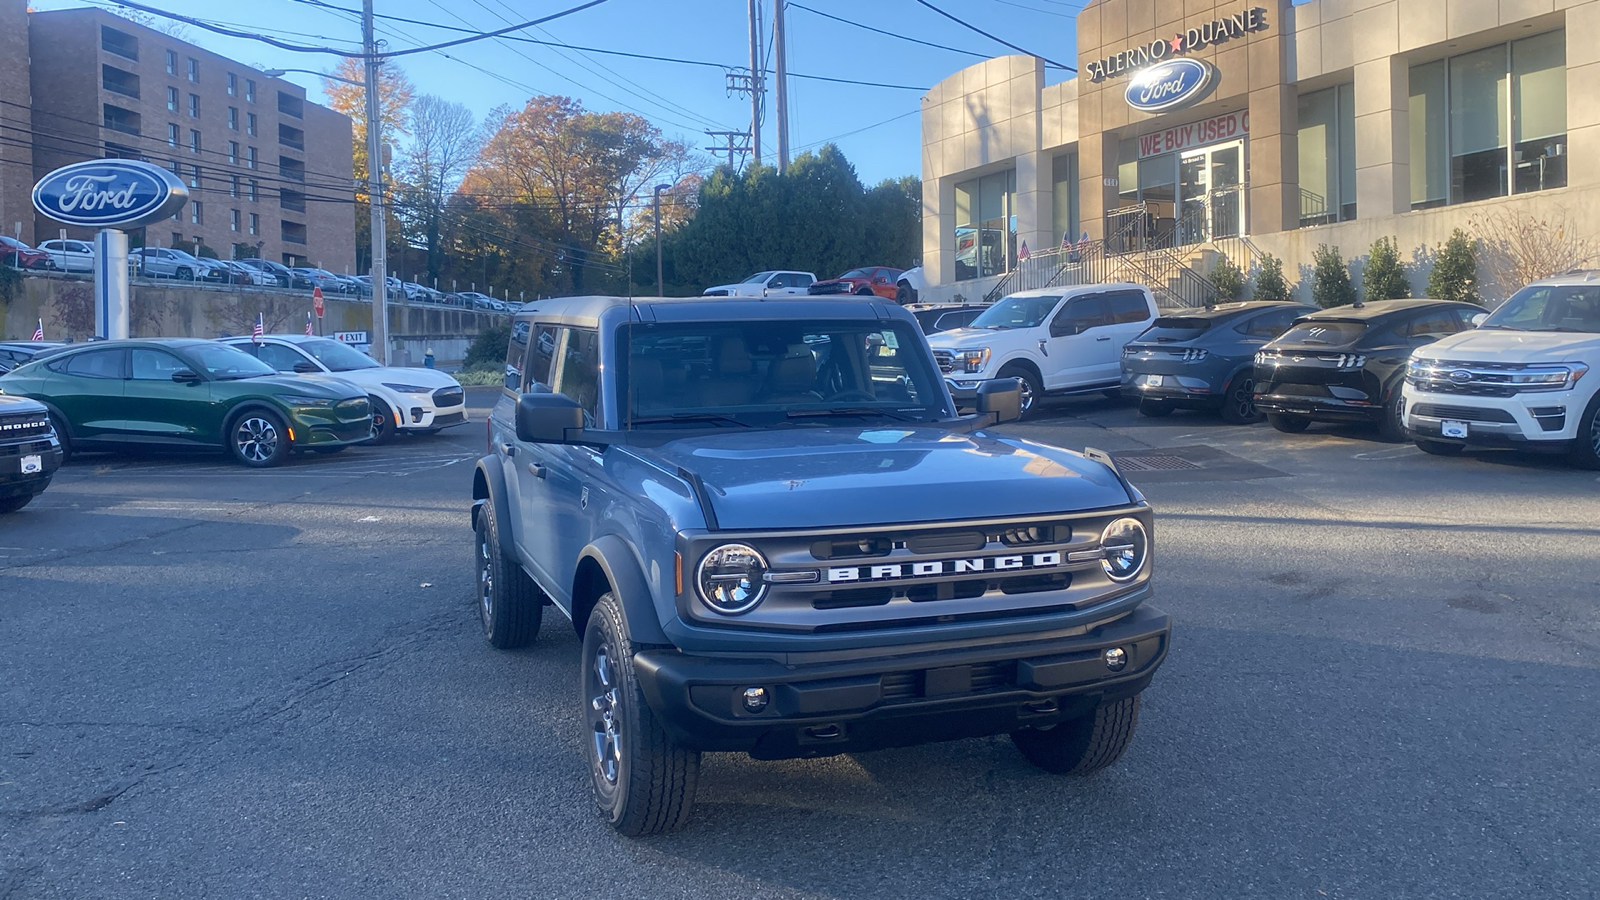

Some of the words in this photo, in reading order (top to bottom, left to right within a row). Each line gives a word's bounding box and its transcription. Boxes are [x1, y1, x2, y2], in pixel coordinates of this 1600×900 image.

[1085, 39, 1166, 82] SALERNO
[1186, 7, 1259, 49] DUANE
[1140, 69, 1185, 103] Ford
[1140, 133, 1161, 157] WE
[1165, 124, 1193, 151] BUY
[1197, 114, 1237, 144] USED
[58, 174, 139, 212] Ford
[345, 333, 363, 341] EXIT
[0, 421, 45, 430] RONCO
[827, 552, 1061, 582] BRONCO
